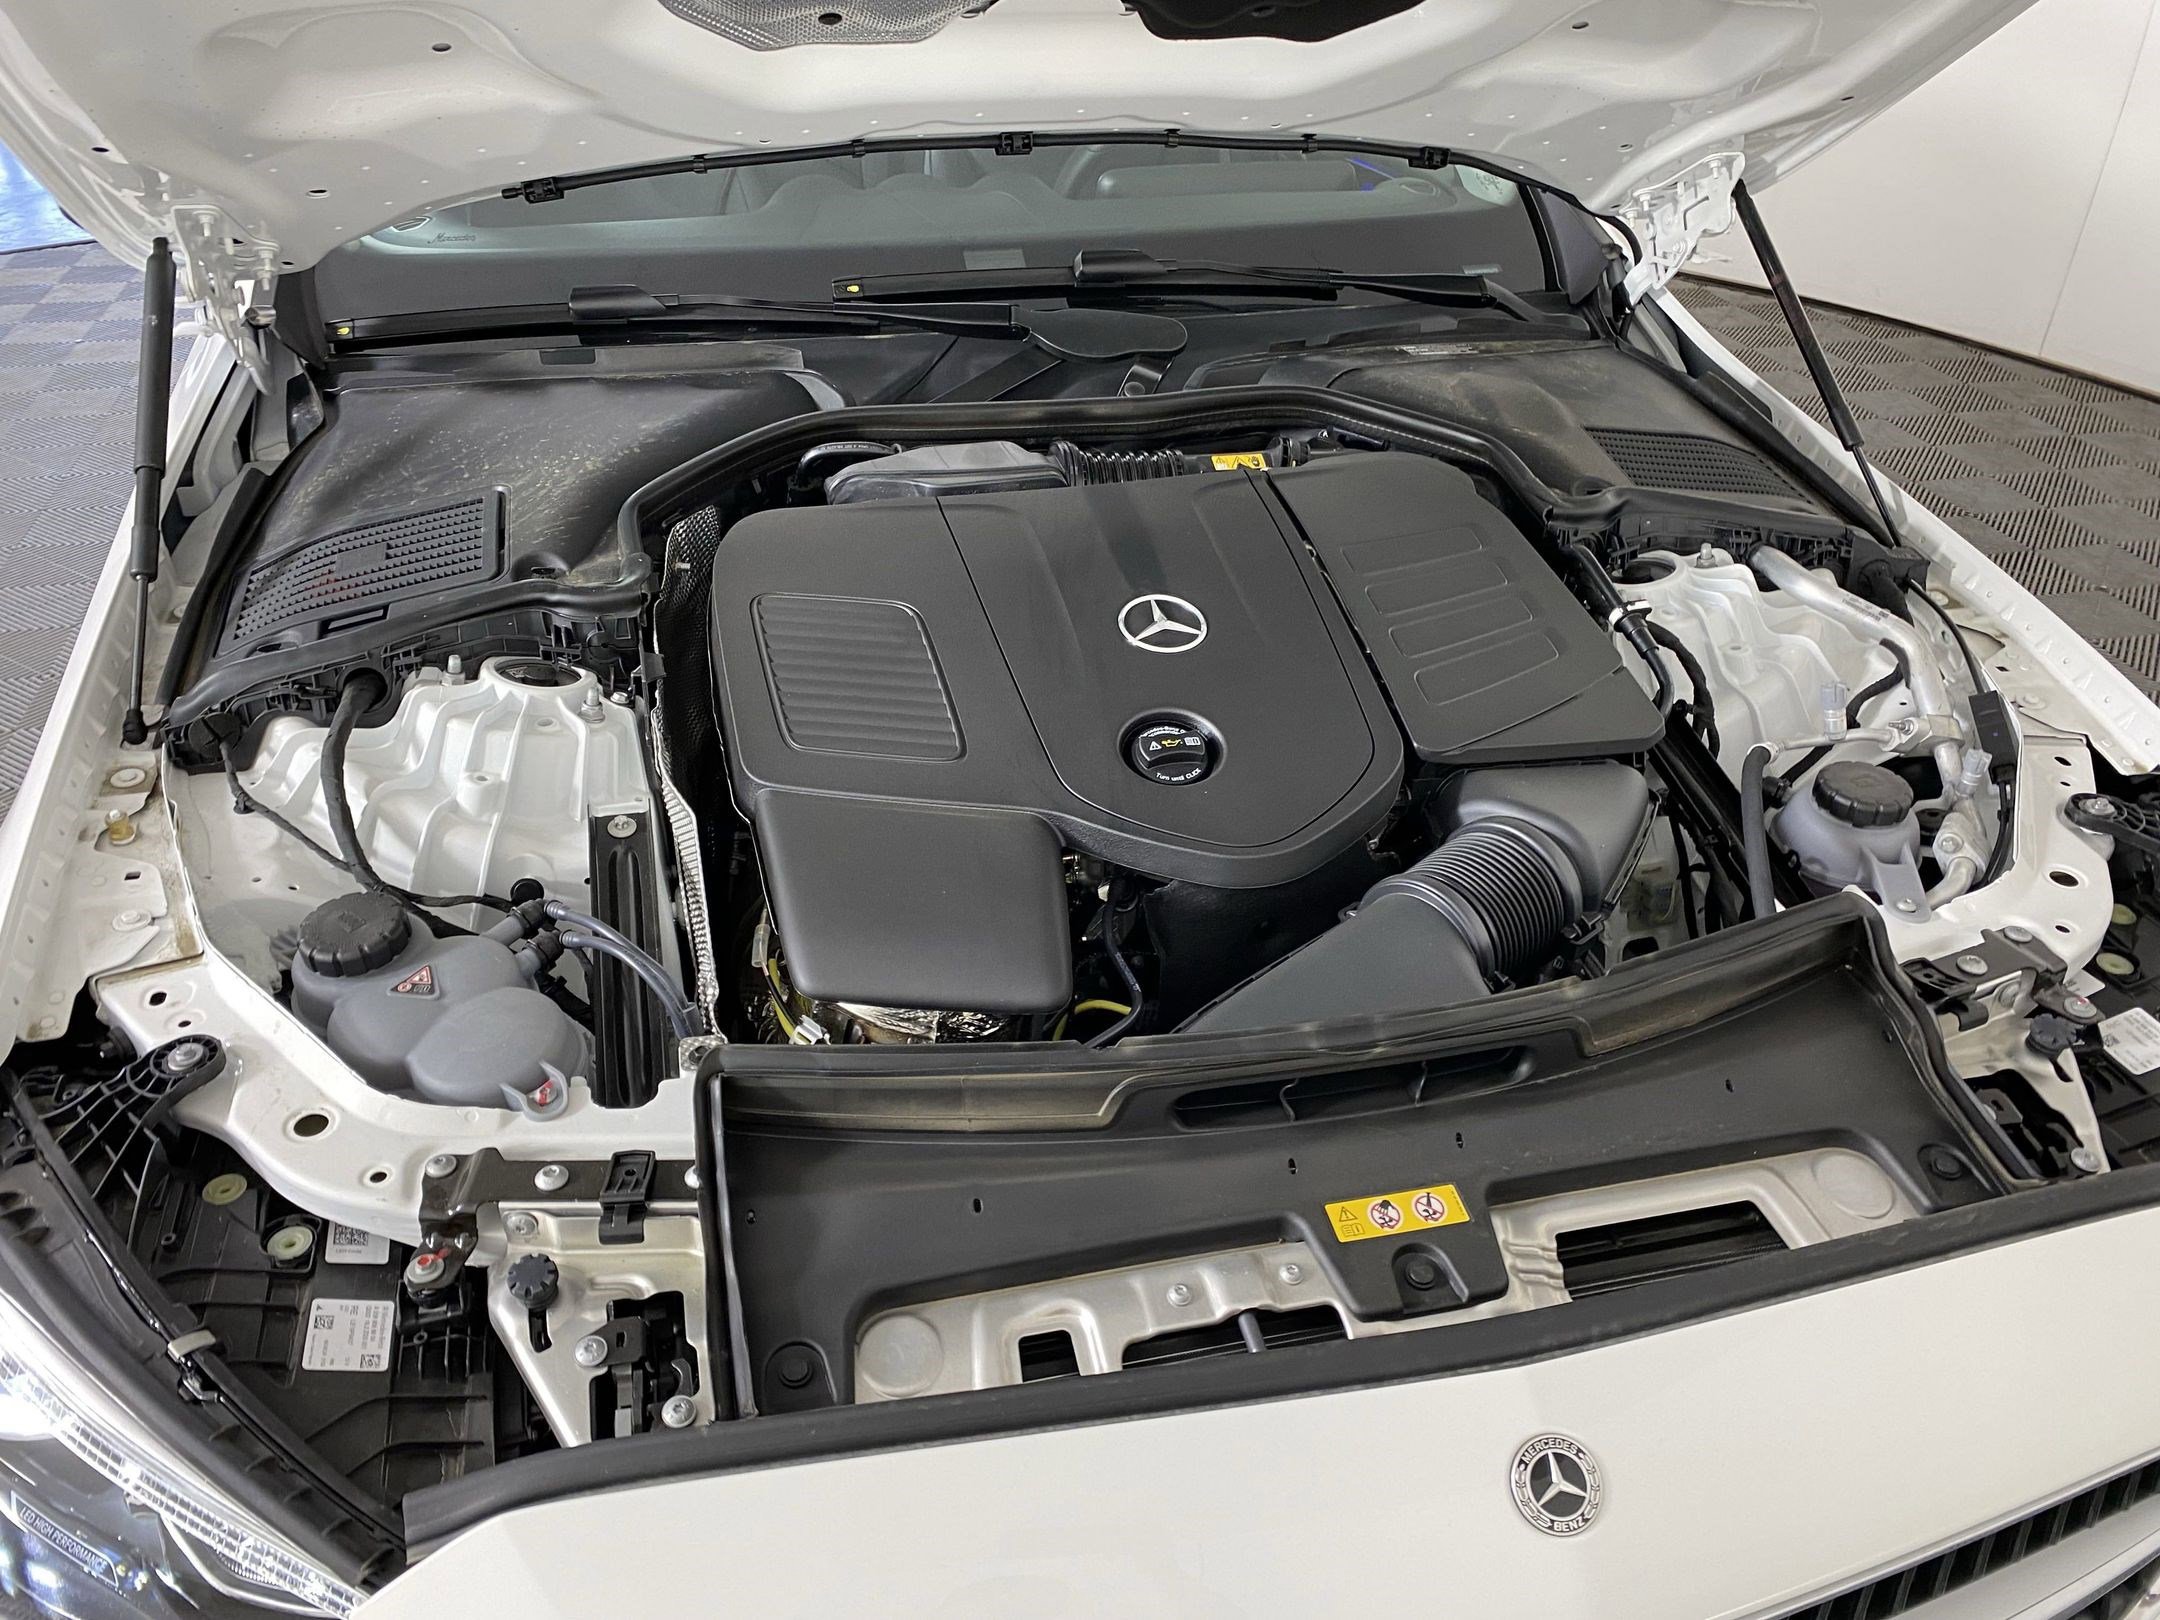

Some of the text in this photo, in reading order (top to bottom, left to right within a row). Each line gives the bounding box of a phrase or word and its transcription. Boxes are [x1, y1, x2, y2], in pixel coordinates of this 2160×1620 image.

[1156, 772, 1170, 781] Turn
[1521, 1438, 1577, 1464] MERCEDES
[1553, 1517, 1586, 1532] BENZ
[19, 1507, 108, 1574] LED HIGH PERFORMANCE
